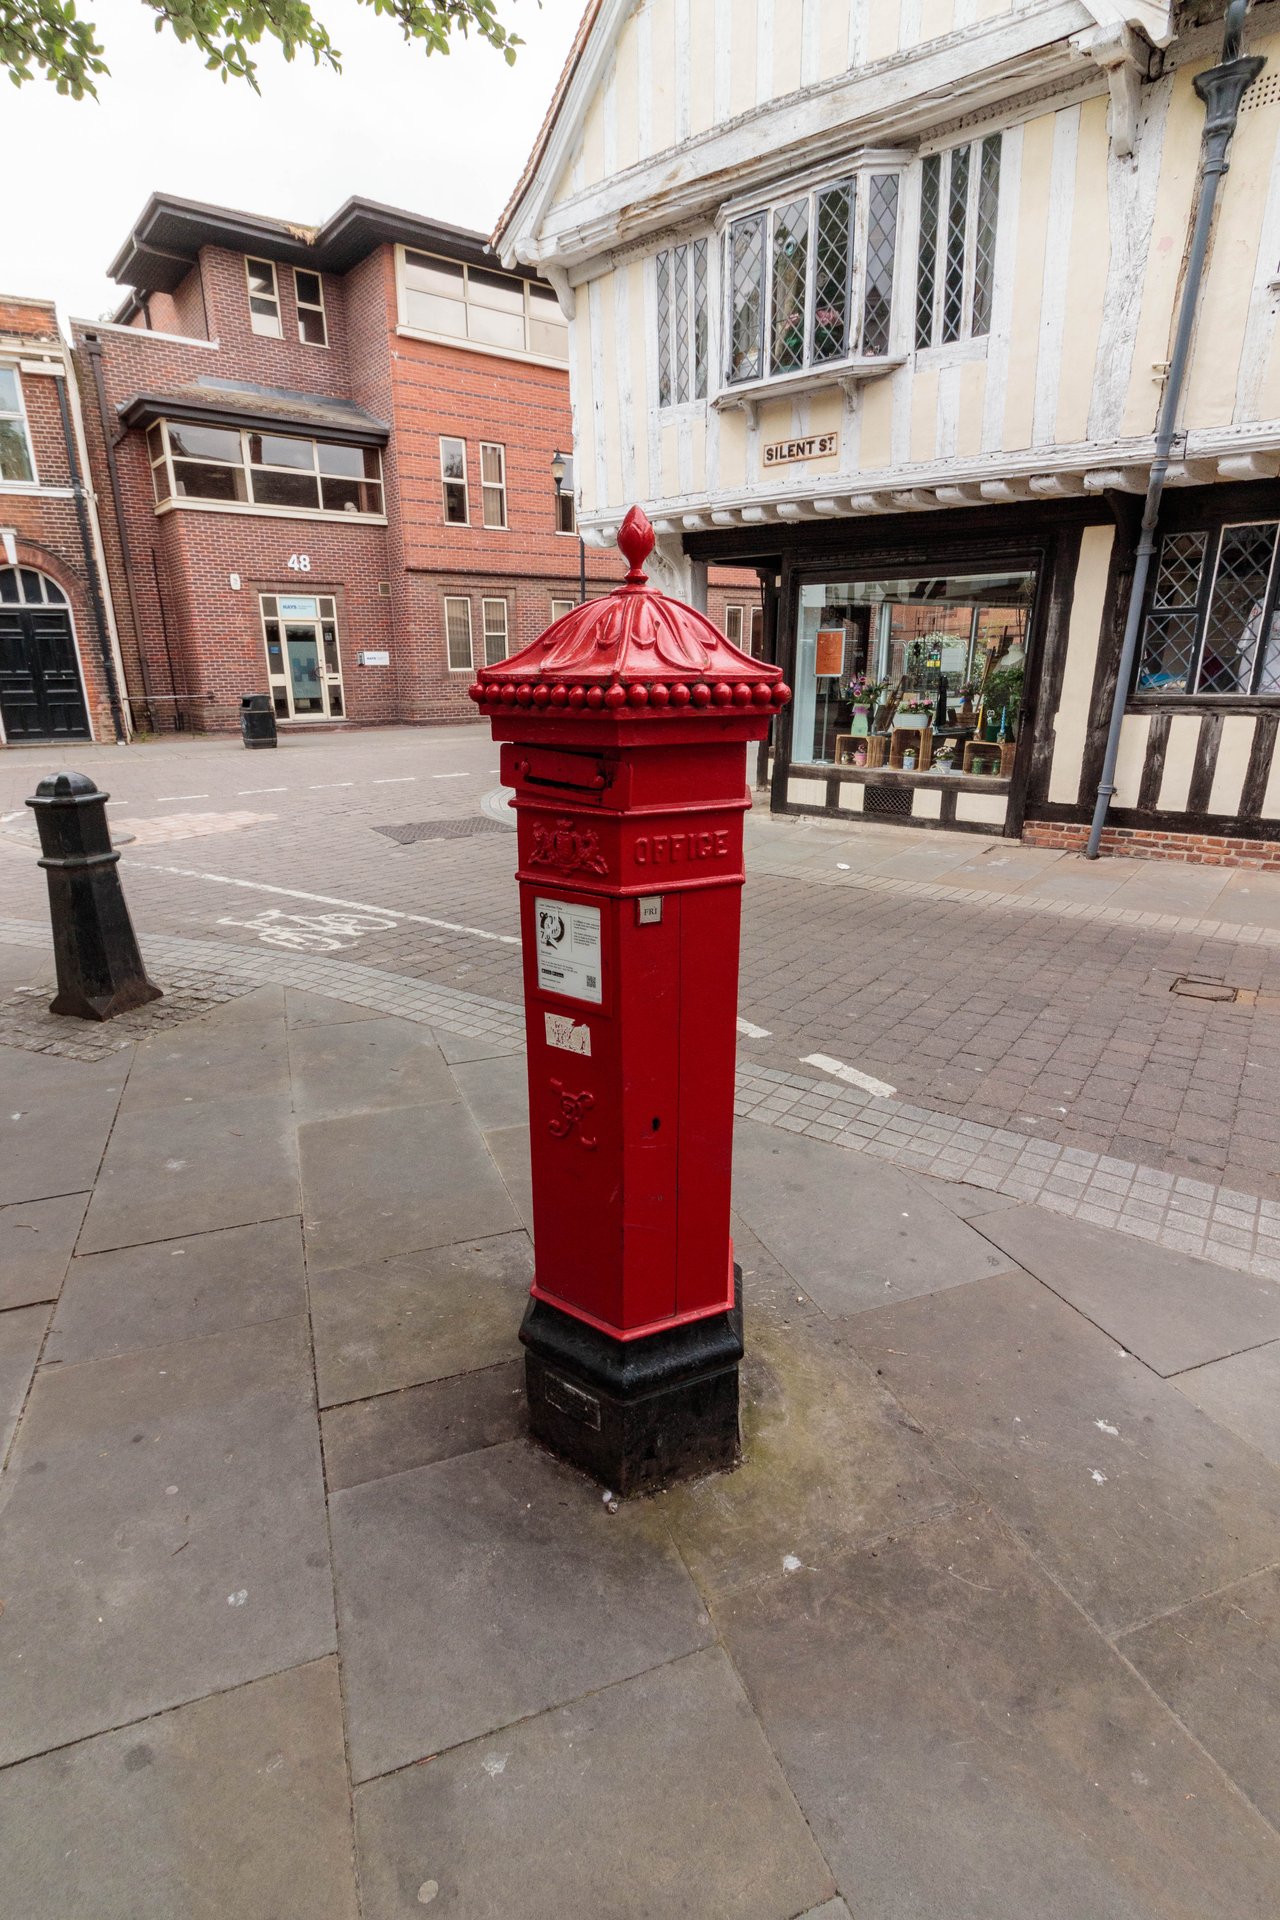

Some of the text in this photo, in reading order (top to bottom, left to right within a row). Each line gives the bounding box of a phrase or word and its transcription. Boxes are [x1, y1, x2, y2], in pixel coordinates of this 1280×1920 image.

[766, 440, 815, 461] SILENT
[287, 554, 311, 572] 48
[635, 829, 730, 864] OFFICE
[644, 907, 658, 916] FRI
